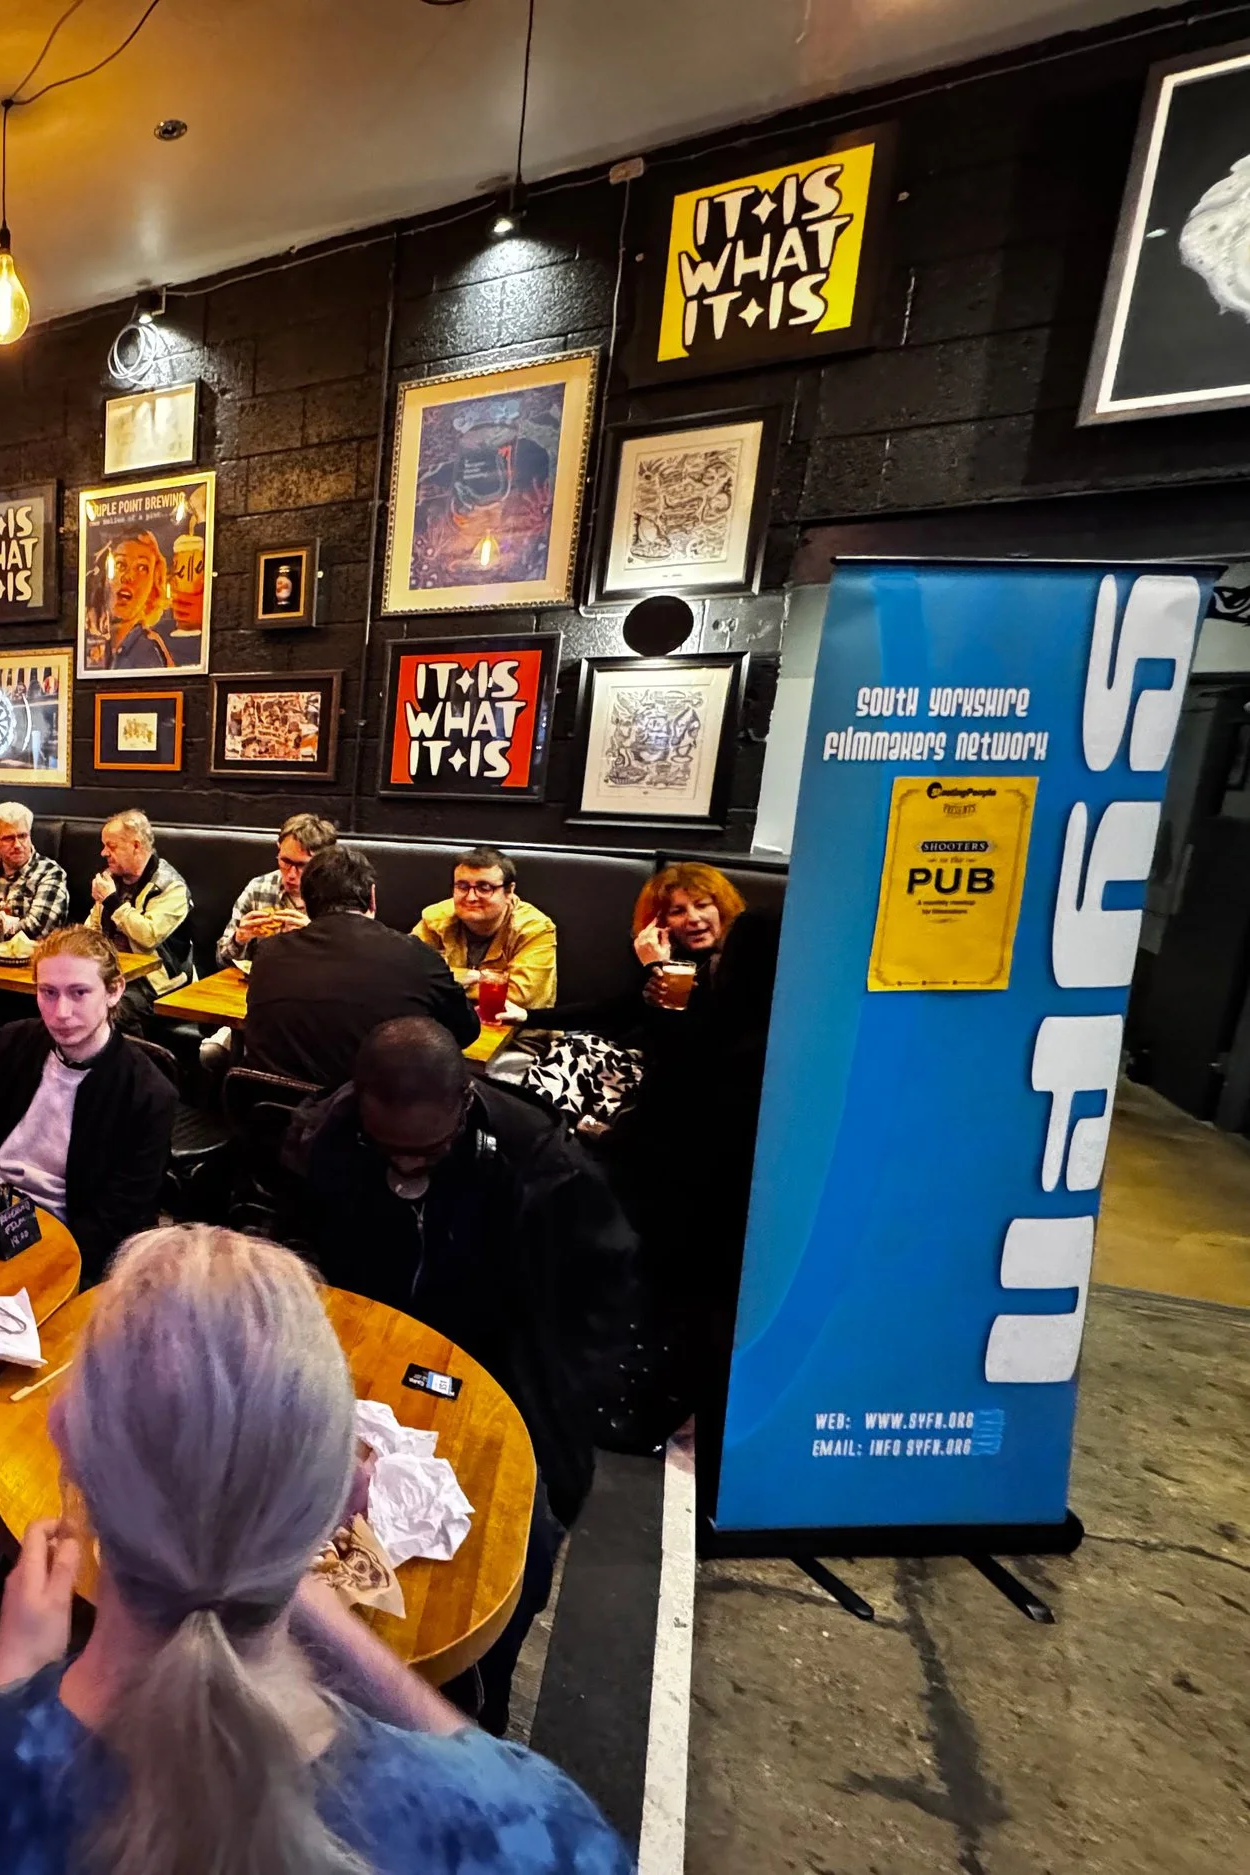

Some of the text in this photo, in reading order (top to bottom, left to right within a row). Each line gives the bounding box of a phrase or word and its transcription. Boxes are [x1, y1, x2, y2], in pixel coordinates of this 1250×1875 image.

[696, 165, 843, 246] IT IS
[679, 216, 854, 298] WHAT
[684, 273, 827, 346] IT IS
[118, 497, 144, 514] POINT
[7, 506, 33, 539] IS
[7, 570, 32, 602] IS
[416, 660, 519, 699] IT IS
[405, 700, 527, 738] WHAT
[409, 740, 511, 778] IT IS
[923, 842, 986, 851] SHOOTERS
[907, 868, 995, 895] PUB
[815, 1413, 851, 1430] WEB:
[812, 1439, 862, 1457] EMAIL:
